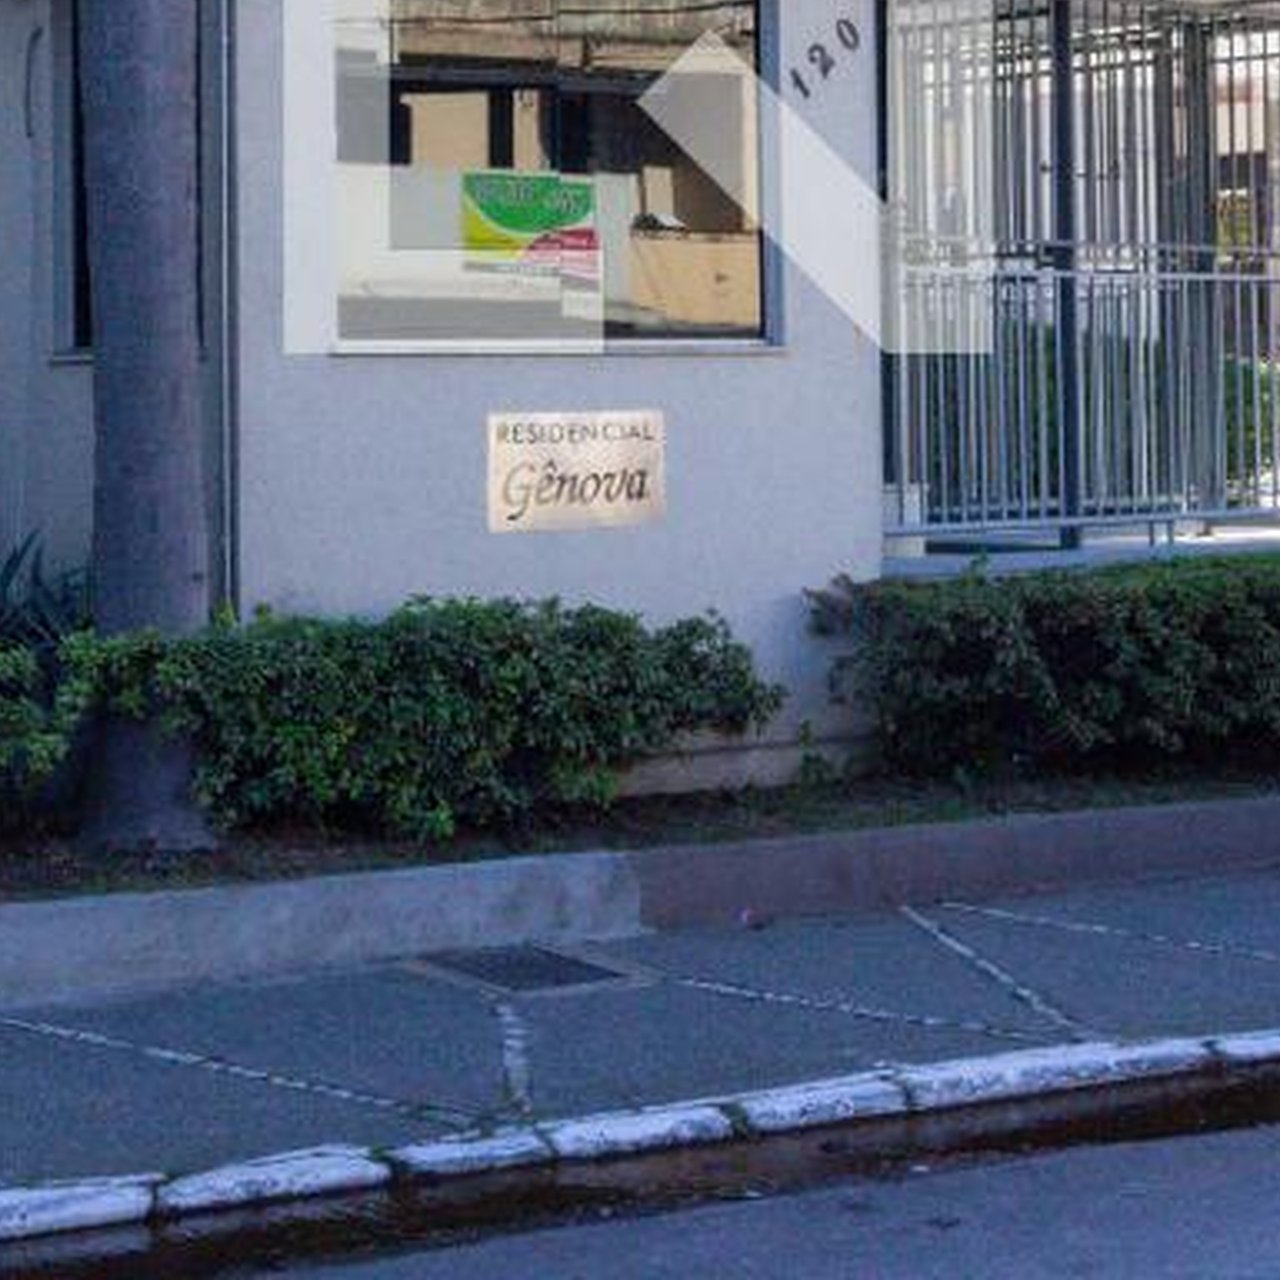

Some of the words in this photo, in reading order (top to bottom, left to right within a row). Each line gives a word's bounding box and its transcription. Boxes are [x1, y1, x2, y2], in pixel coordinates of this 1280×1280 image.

[790, 19, 860, 99] 120
[496, 421, 654, 444] RESIDENCIAL
[503, 458, 648, 521] Gênova
